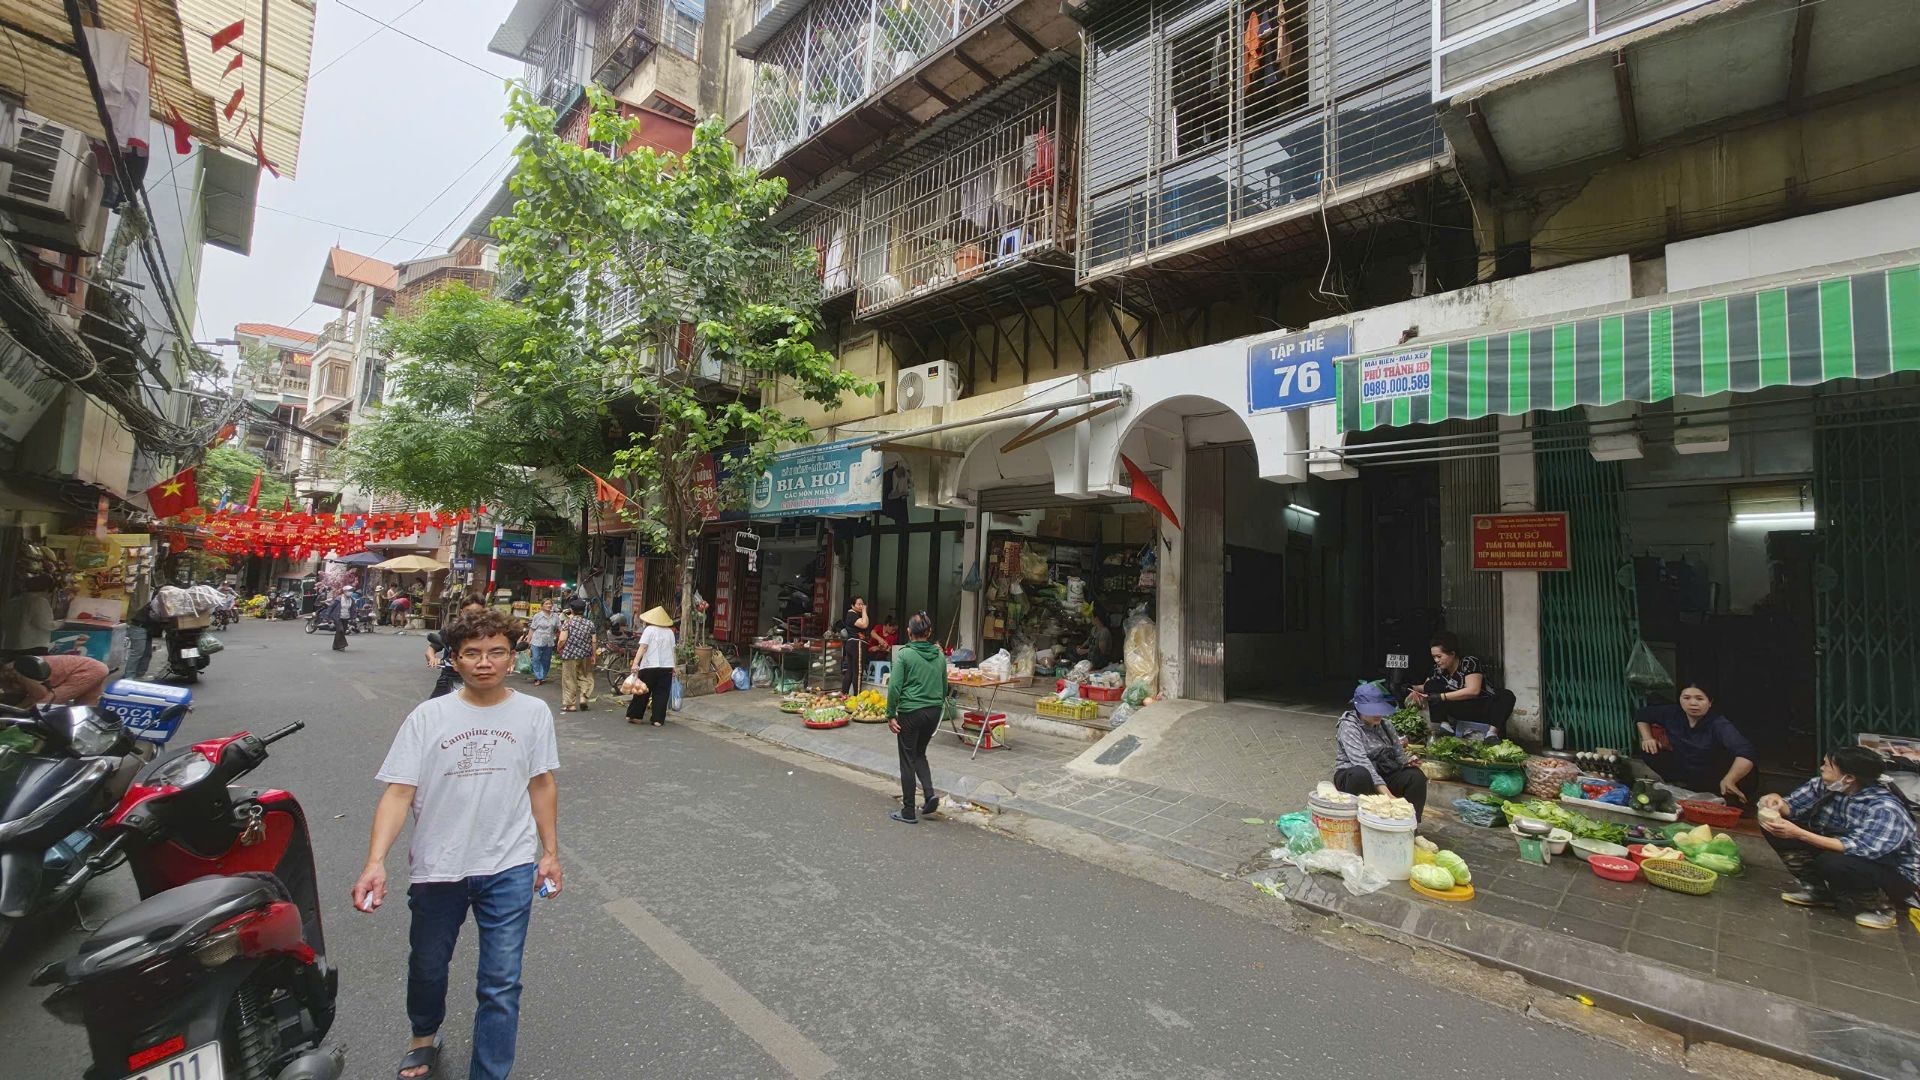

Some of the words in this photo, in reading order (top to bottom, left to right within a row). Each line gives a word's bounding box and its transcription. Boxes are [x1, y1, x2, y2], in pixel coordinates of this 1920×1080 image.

[1270, 344, 1296, 362] TẬP
[1300, 330, 1326, 352] THỂ
[1274, 361, 1321, 398] 76
[1383, 363, 1414, 378] THÀNH
[1364, 374, 1430, 397] 0989.000.589
[776, 476, 806, 492] BIA
[811, 470, 846, 488] HƠI
[1498, 532, 1520, 540] TRỤ
[1524, 530, 1540, 539] SỞ
[440, 728, 488, 750] Camping
[490, 729, 517, 744] coffee
